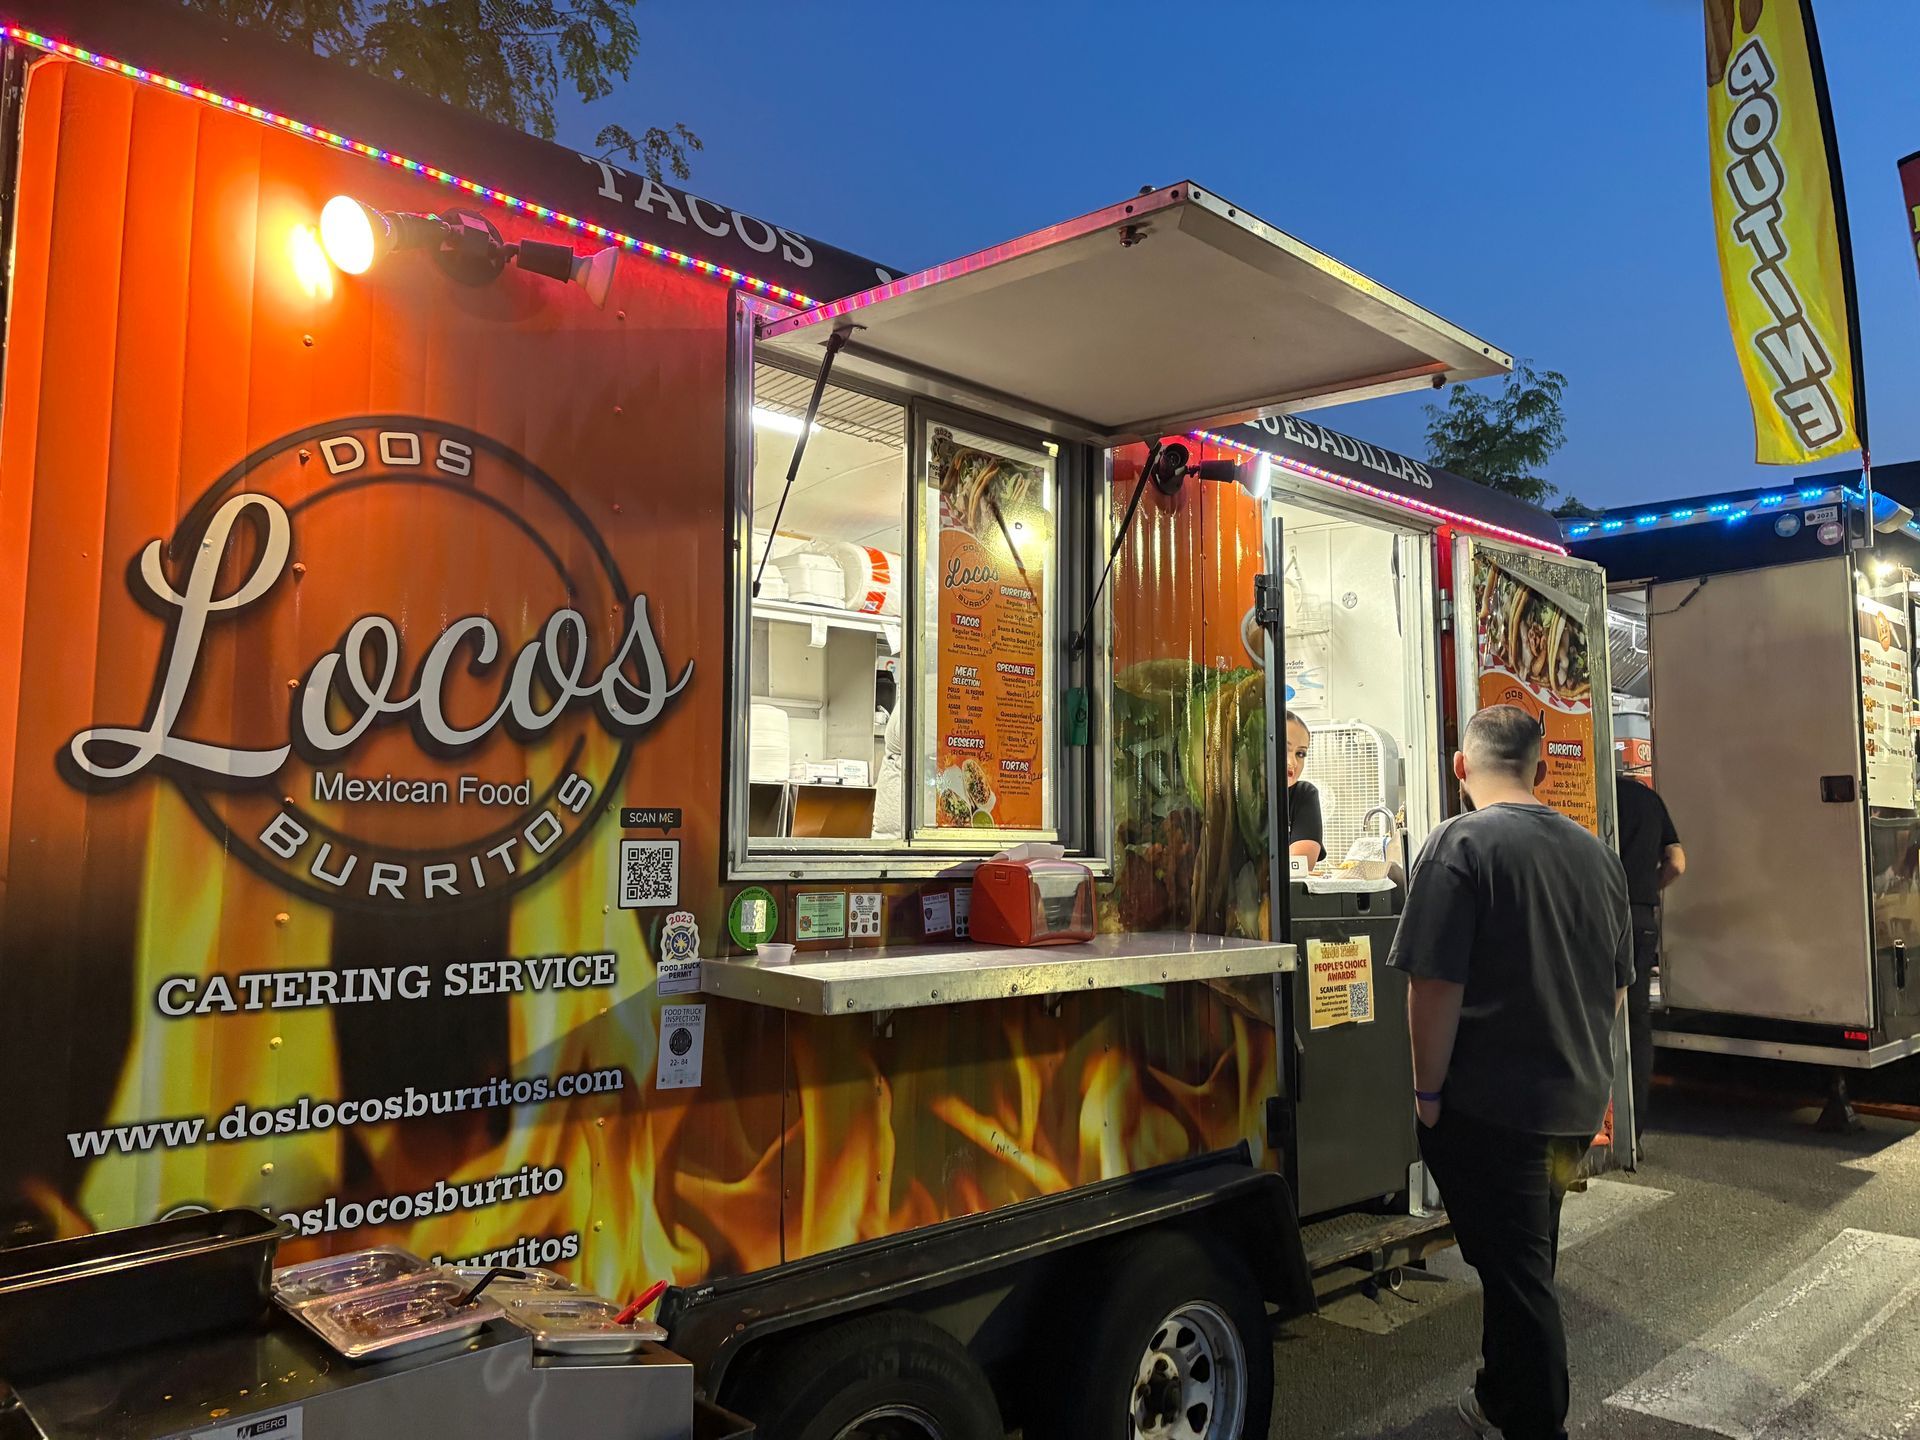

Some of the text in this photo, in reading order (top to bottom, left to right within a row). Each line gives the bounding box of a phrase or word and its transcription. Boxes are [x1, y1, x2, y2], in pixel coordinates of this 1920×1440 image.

[577, 153, 814, 268] TACOS
[321, 432, 473, 478] DOS
[1244, 414, 1433, 489] UESADILLAS
[1001, 586, 1032, 600] BURRITOS
[956, 615, 980, 628] TACOS
[70, 493, 694, 777] Locos
[955, 665, 977, 678] MEAT
[996, 663, 1034, 676] SPECIALTIES
[952, 677, 980, 687] SELECTION
[1505, 690, 1523, 700] DOS
[948, 736, 984, 748] DESSERTS
[1548, 742, 1582, 757] BURRITOS
[1001, 760, 1029, 771] TORTAS
[314, 771, 531, 805] Mexican Food
[629, 812, 674, 823] SCAN ME
[258, 772, 594, 900] BURRITOS
[669, 914, 693, 925] 2023
[660, 962, 701, 972] FOOD TRUCK
[1314, 959, 1367, 973] PEOPLE'S CHOICE
[669, 970, 692, 979] PERMIT
[1327, 970, 1356, 982] AWARDS!
[158, 953, 616, 1017] CATERING SERVICE
[1320, 984, 1347, 994] SCAN HERE
[664, 1007, 701, 1016] FOOD TRUCK
[665, 1015, 701, 1023] INSPECTION
[67, 1067, 624, 1158] www.doslocosburritos.com
[256, 1418, 286, 1433] BERG
